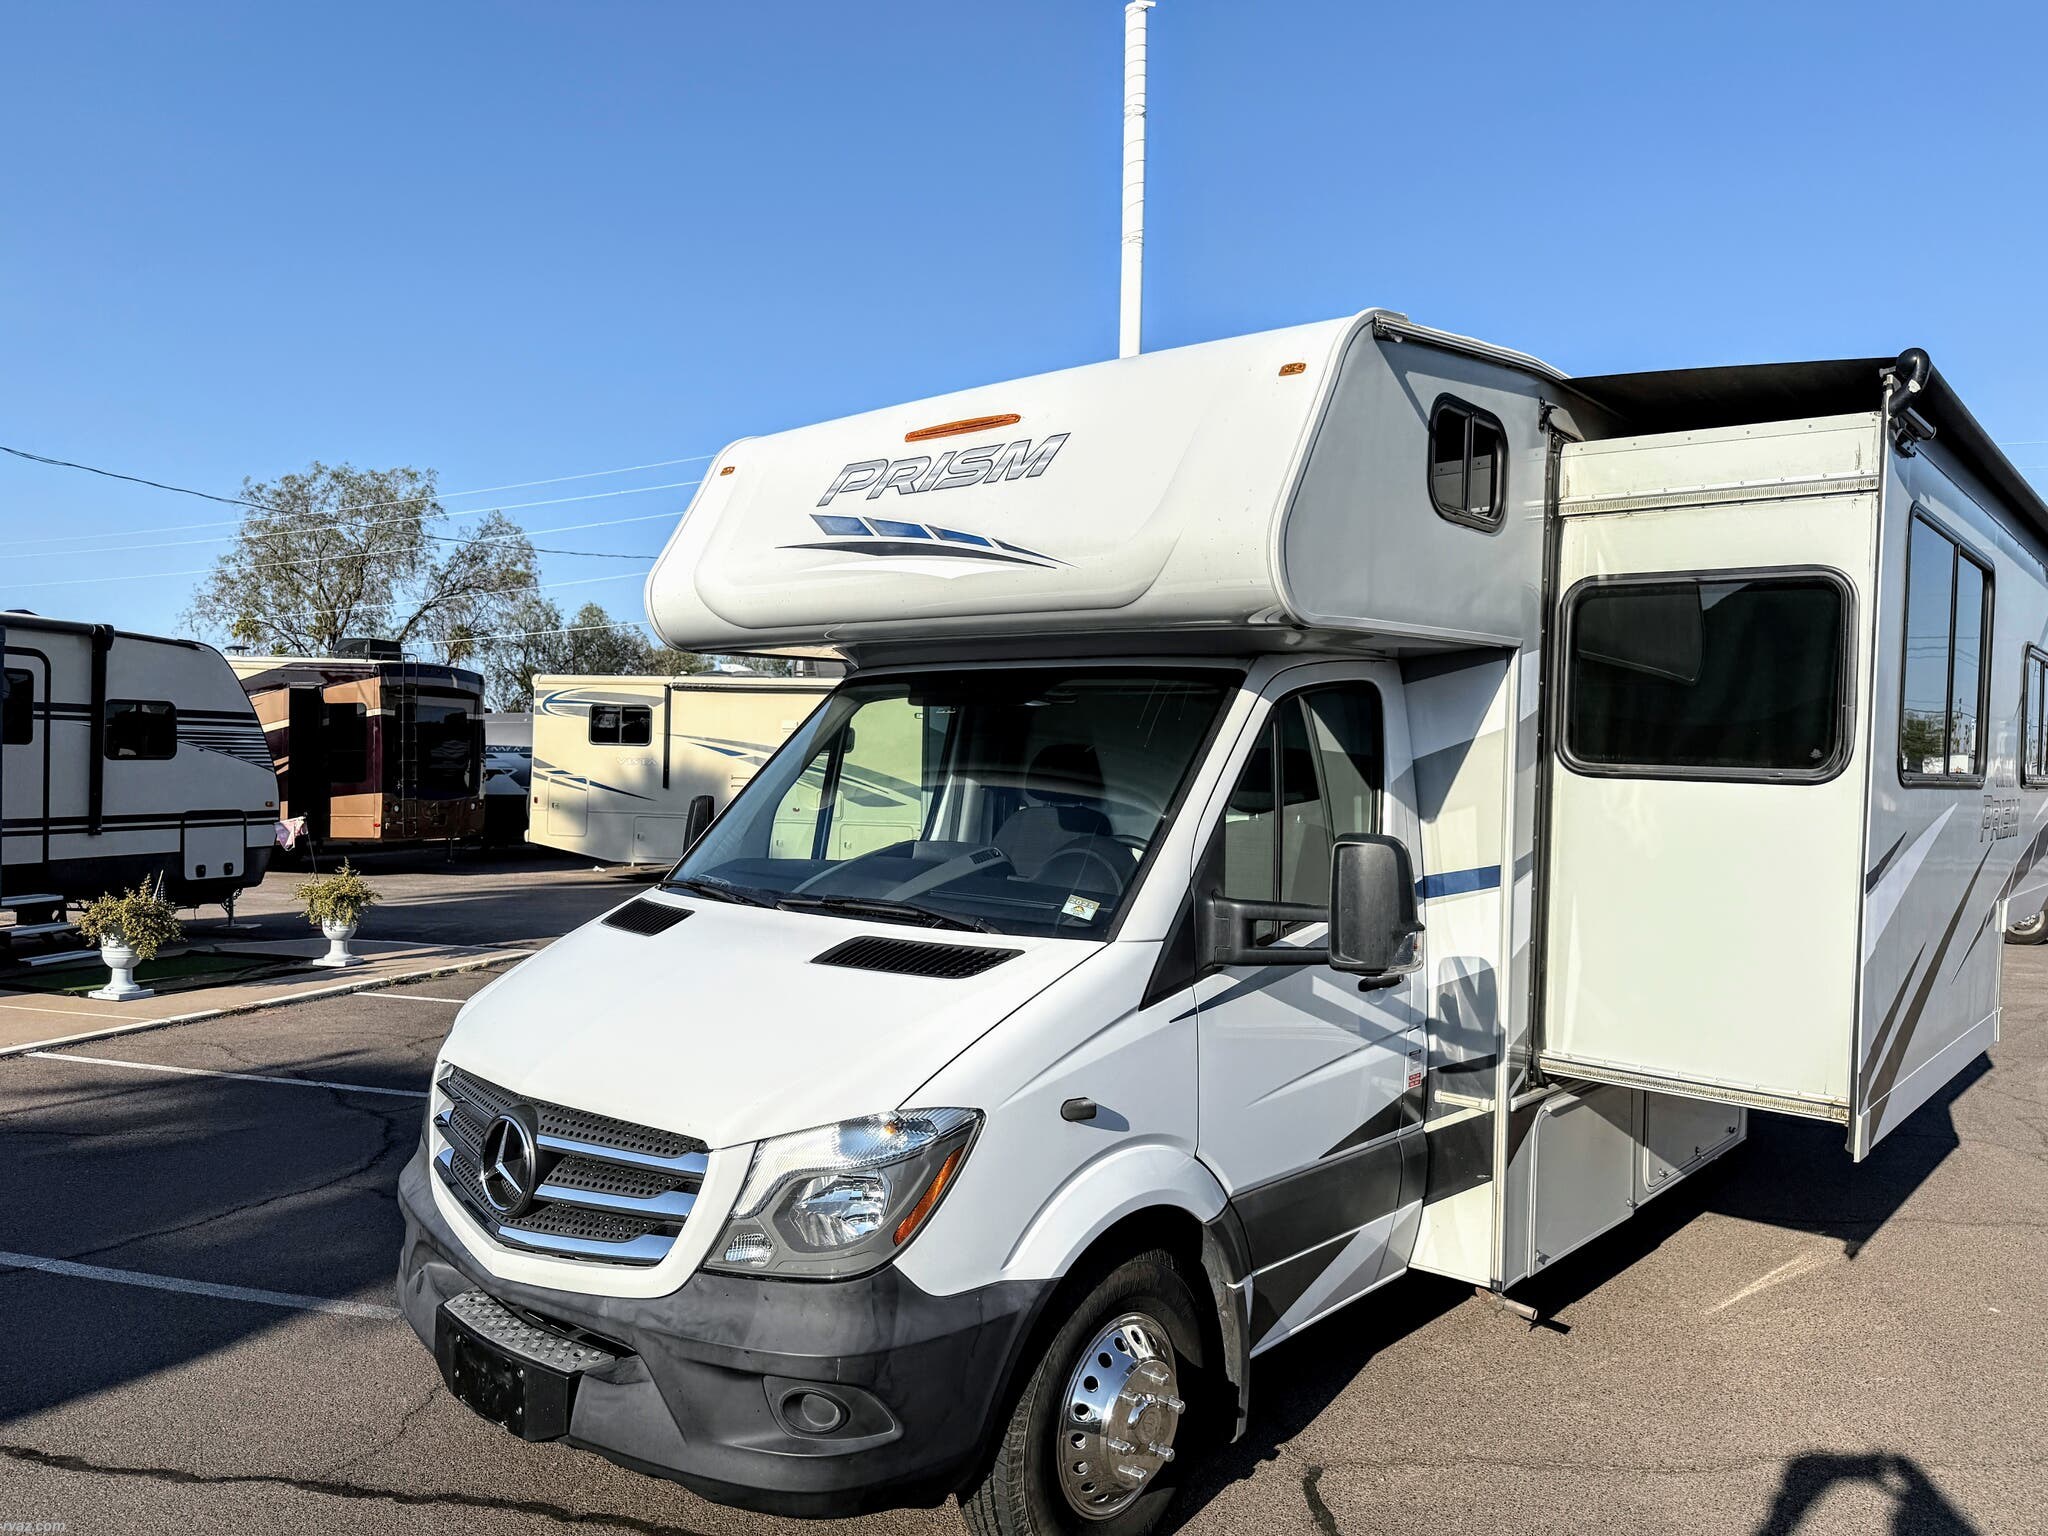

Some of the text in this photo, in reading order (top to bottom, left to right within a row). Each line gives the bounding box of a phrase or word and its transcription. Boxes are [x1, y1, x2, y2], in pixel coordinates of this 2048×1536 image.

[816, 432, 1072, 507] PRISM
[616, 757, 657, 766] VISTA
[1980, 794, 2020, 842] PRISM
